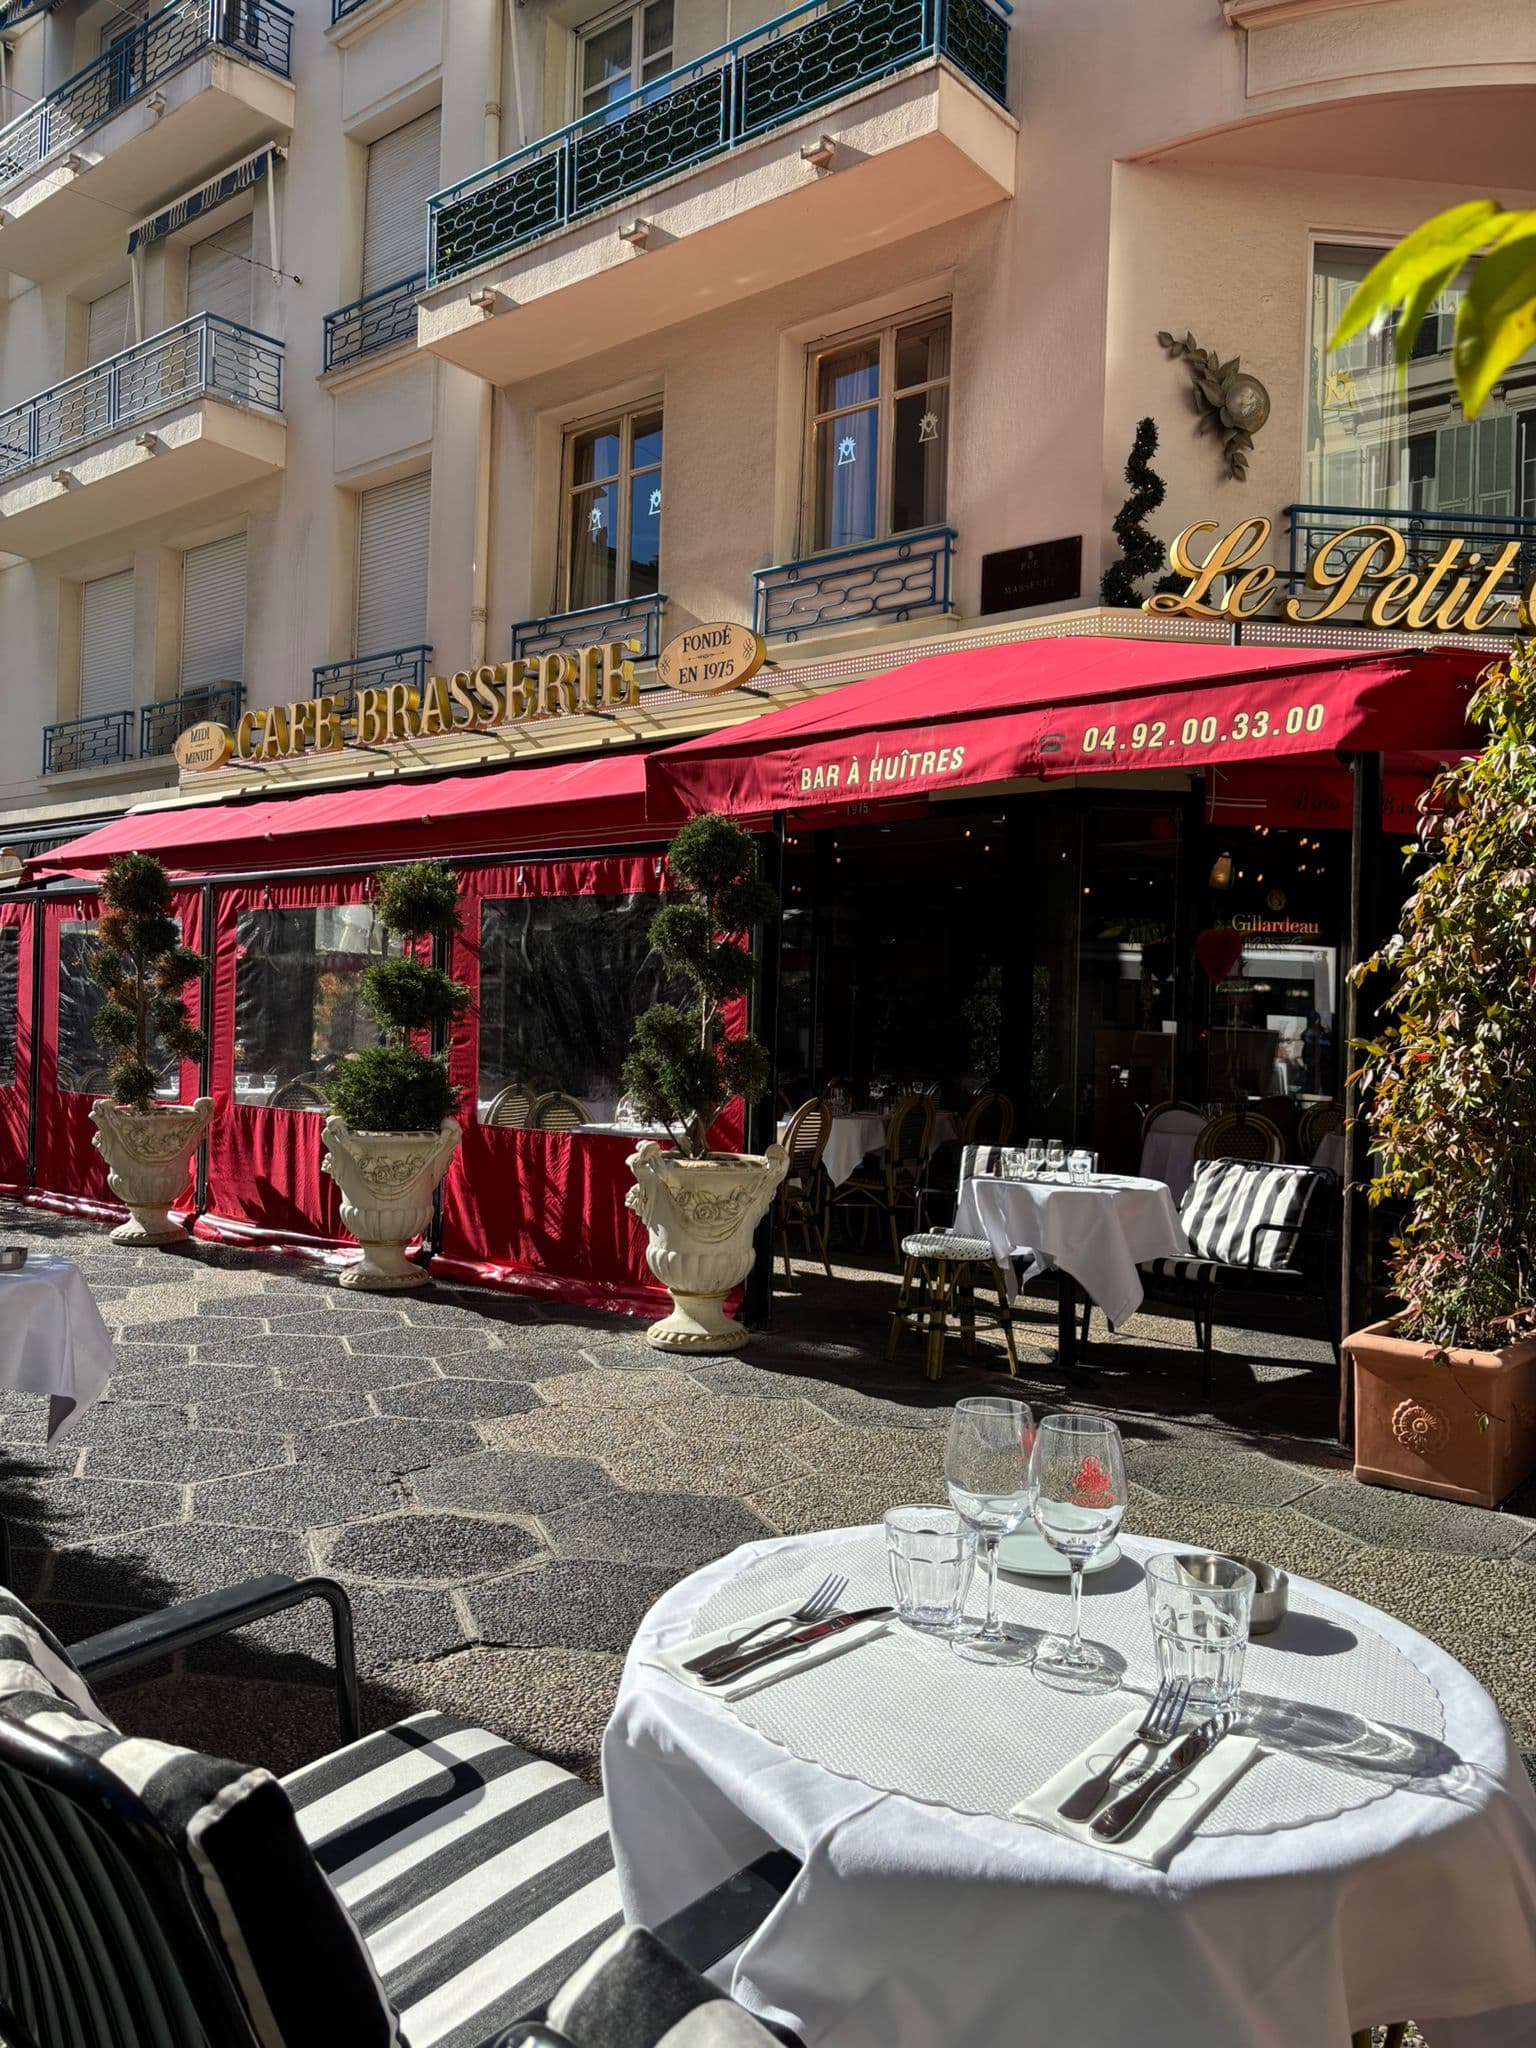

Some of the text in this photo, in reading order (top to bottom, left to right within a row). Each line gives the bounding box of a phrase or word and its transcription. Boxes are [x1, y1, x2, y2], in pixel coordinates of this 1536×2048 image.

[1142, 517, 1278, 623] Le
[1282, 523, 1521, 634] Petit
[682, 624, 732, 653] FONDÉ
[678, 659, 735, 684] EN 1975
[354, 638, 641, 746] BRASSERIE
[190, 727, 210, 743] MIDI
[1081, 703, 1326, 753] 04.92.00.33.00
[185, 748, 214, 765] MINUIT
[800, 745, 966, 791] BAR À HUÎTRES
[1231, 914, 1320, 934] Gillardeau
